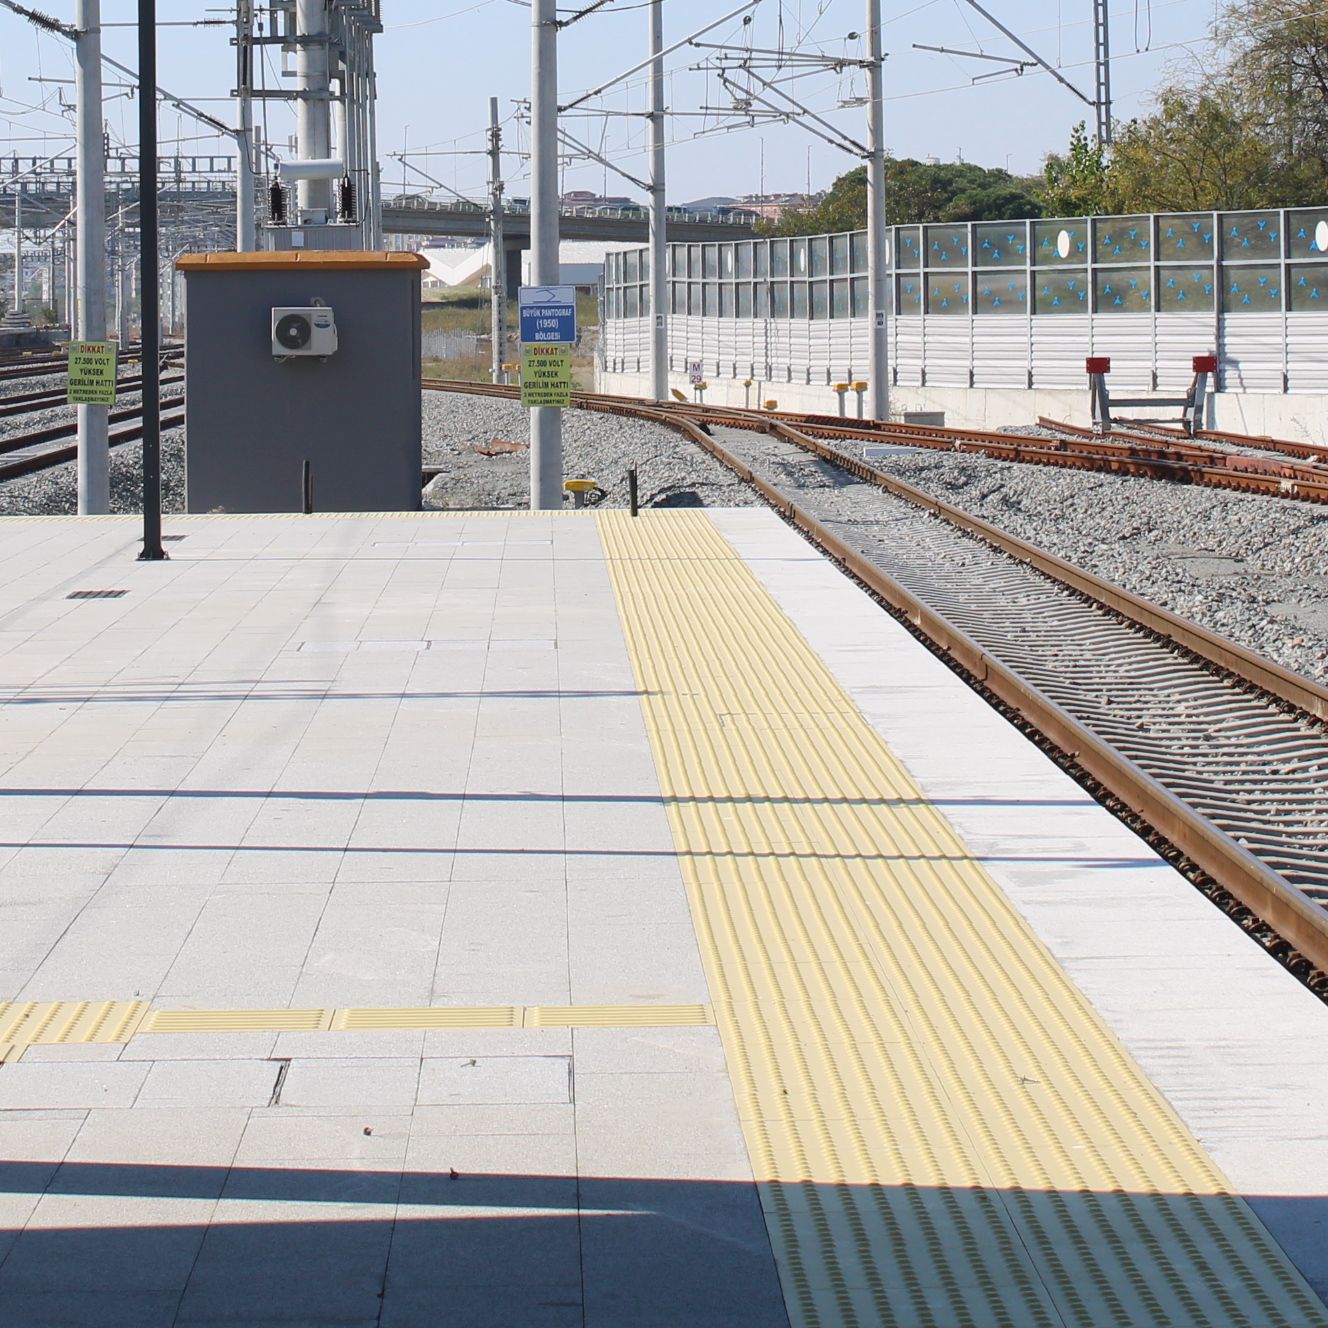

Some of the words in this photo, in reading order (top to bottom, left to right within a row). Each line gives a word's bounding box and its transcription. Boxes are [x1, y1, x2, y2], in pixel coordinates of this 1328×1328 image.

[522, 308, 541, 318] BÜYÜK
[542, 308, 572, 317] PANTOGRAF
[536, 319, 559, 330] (1950)
[535, 331, 560, 340] BÖLGESİ
[80, 344, 104, 354] DİKKAT
[533, 347, 558, 356] DİKKAT
[75, 357, 93, 365] 27.500
[80, 367, 104, 375] YÜKSEK
[534, 369, 559, 378] YÜKSEK
[70, 378, 94, 386] GERİLİM
[692, 375, 702, 383] 29
[524, 380, 549, 389] GERİLİM
[551, 381, 568, 389] HATTI
